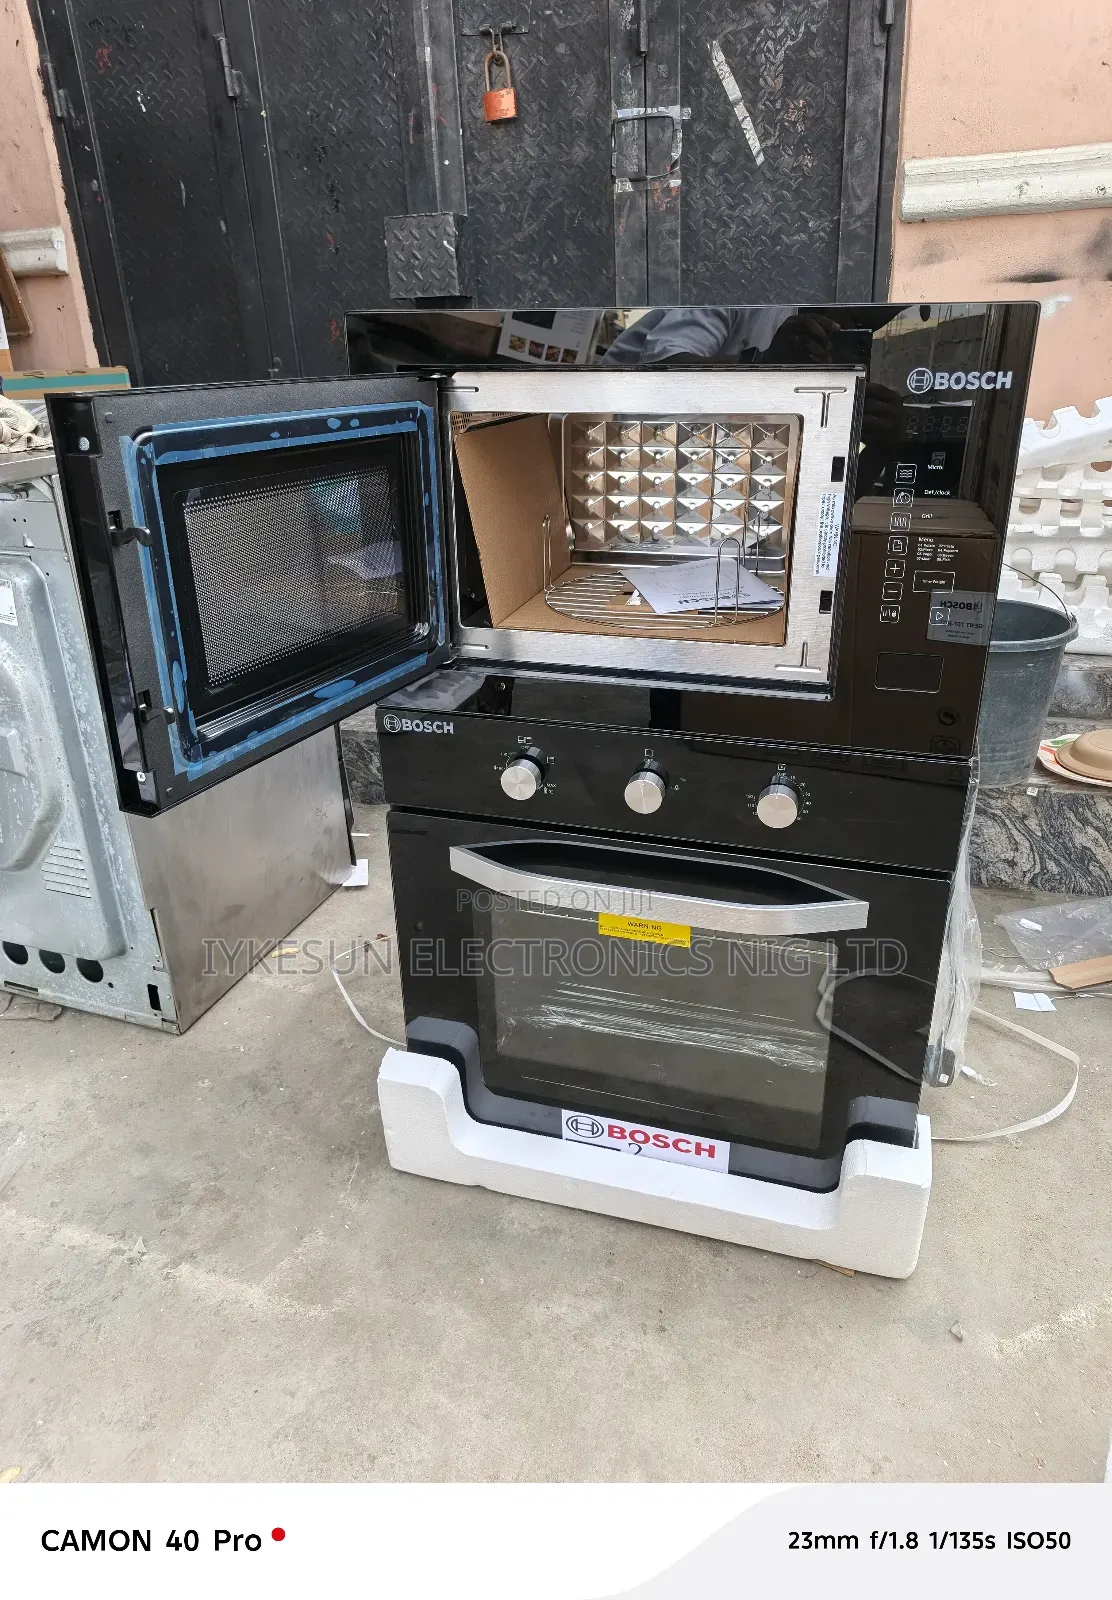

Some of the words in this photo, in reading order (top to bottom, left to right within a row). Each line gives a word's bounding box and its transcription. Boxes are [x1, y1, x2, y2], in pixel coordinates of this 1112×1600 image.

[934, 371, 1013, 390] BOSCH
[400, 718, 454, 735] BOSCH
[607, 1124, 716, 1158] BOSCH
